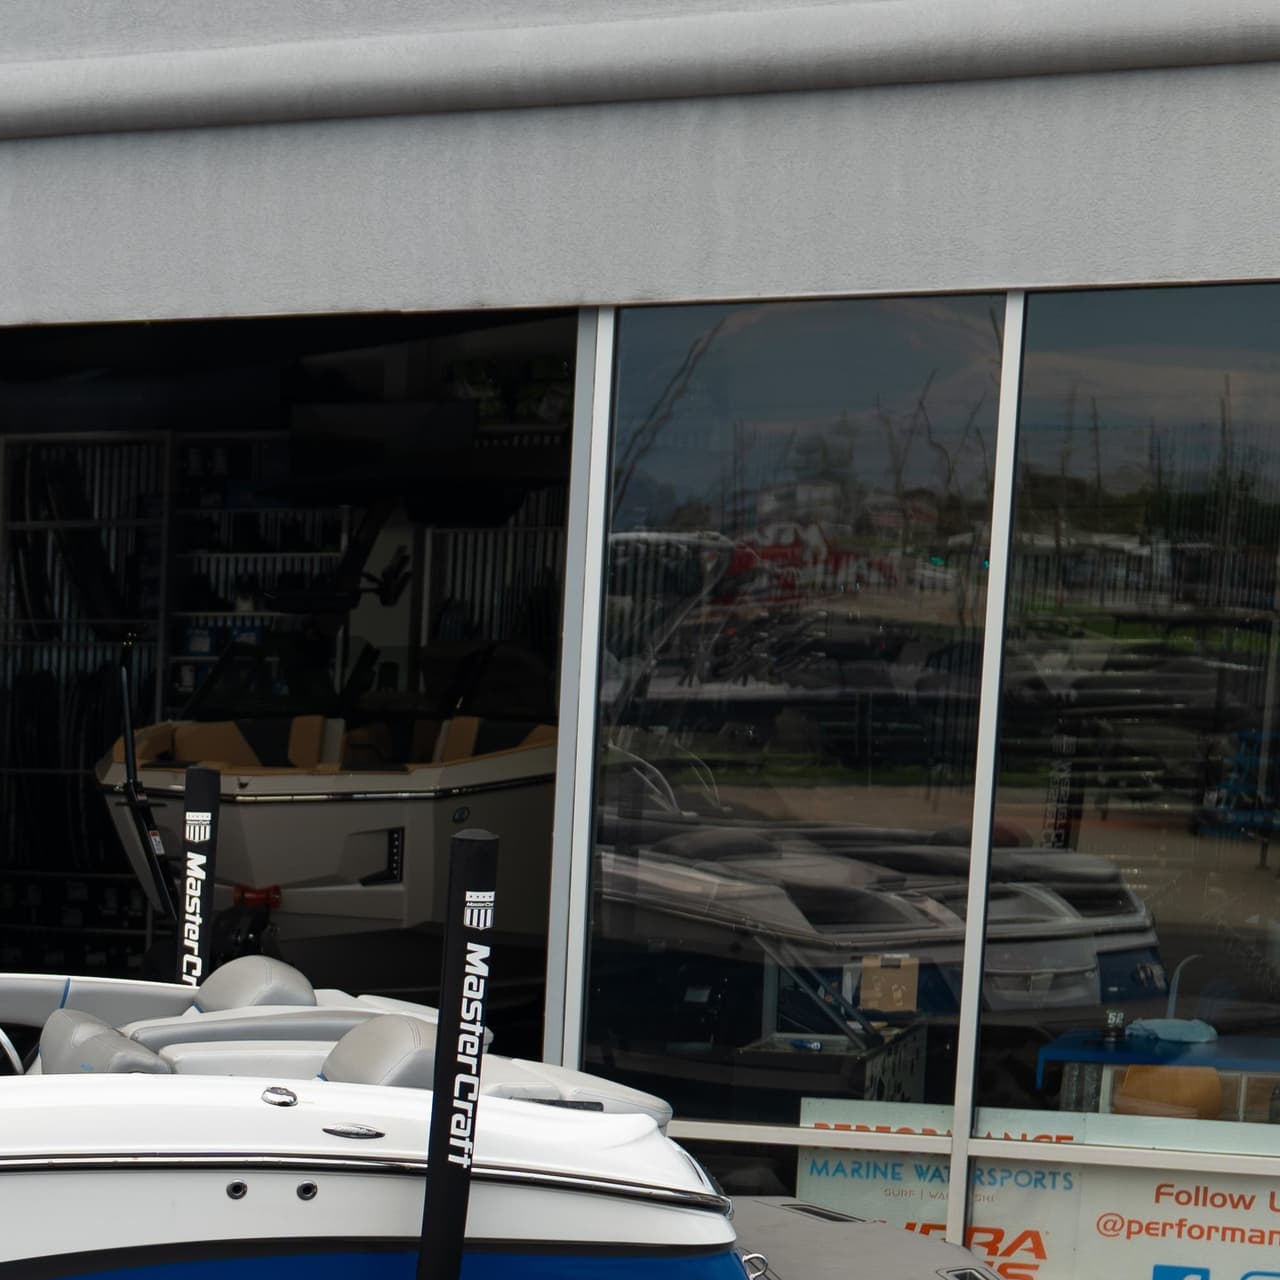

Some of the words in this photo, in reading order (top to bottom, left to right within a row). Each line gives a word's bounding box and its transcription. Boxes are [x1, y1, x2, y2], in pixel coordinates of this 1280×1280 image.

[447, 942, 491, 1169] MasterCraft
[809, 1159, 905, 1182] MARINE
[914, 1163, 1074, 1191] WATRSPORTS
[1154, 1183, 1257, 1211] Follow
